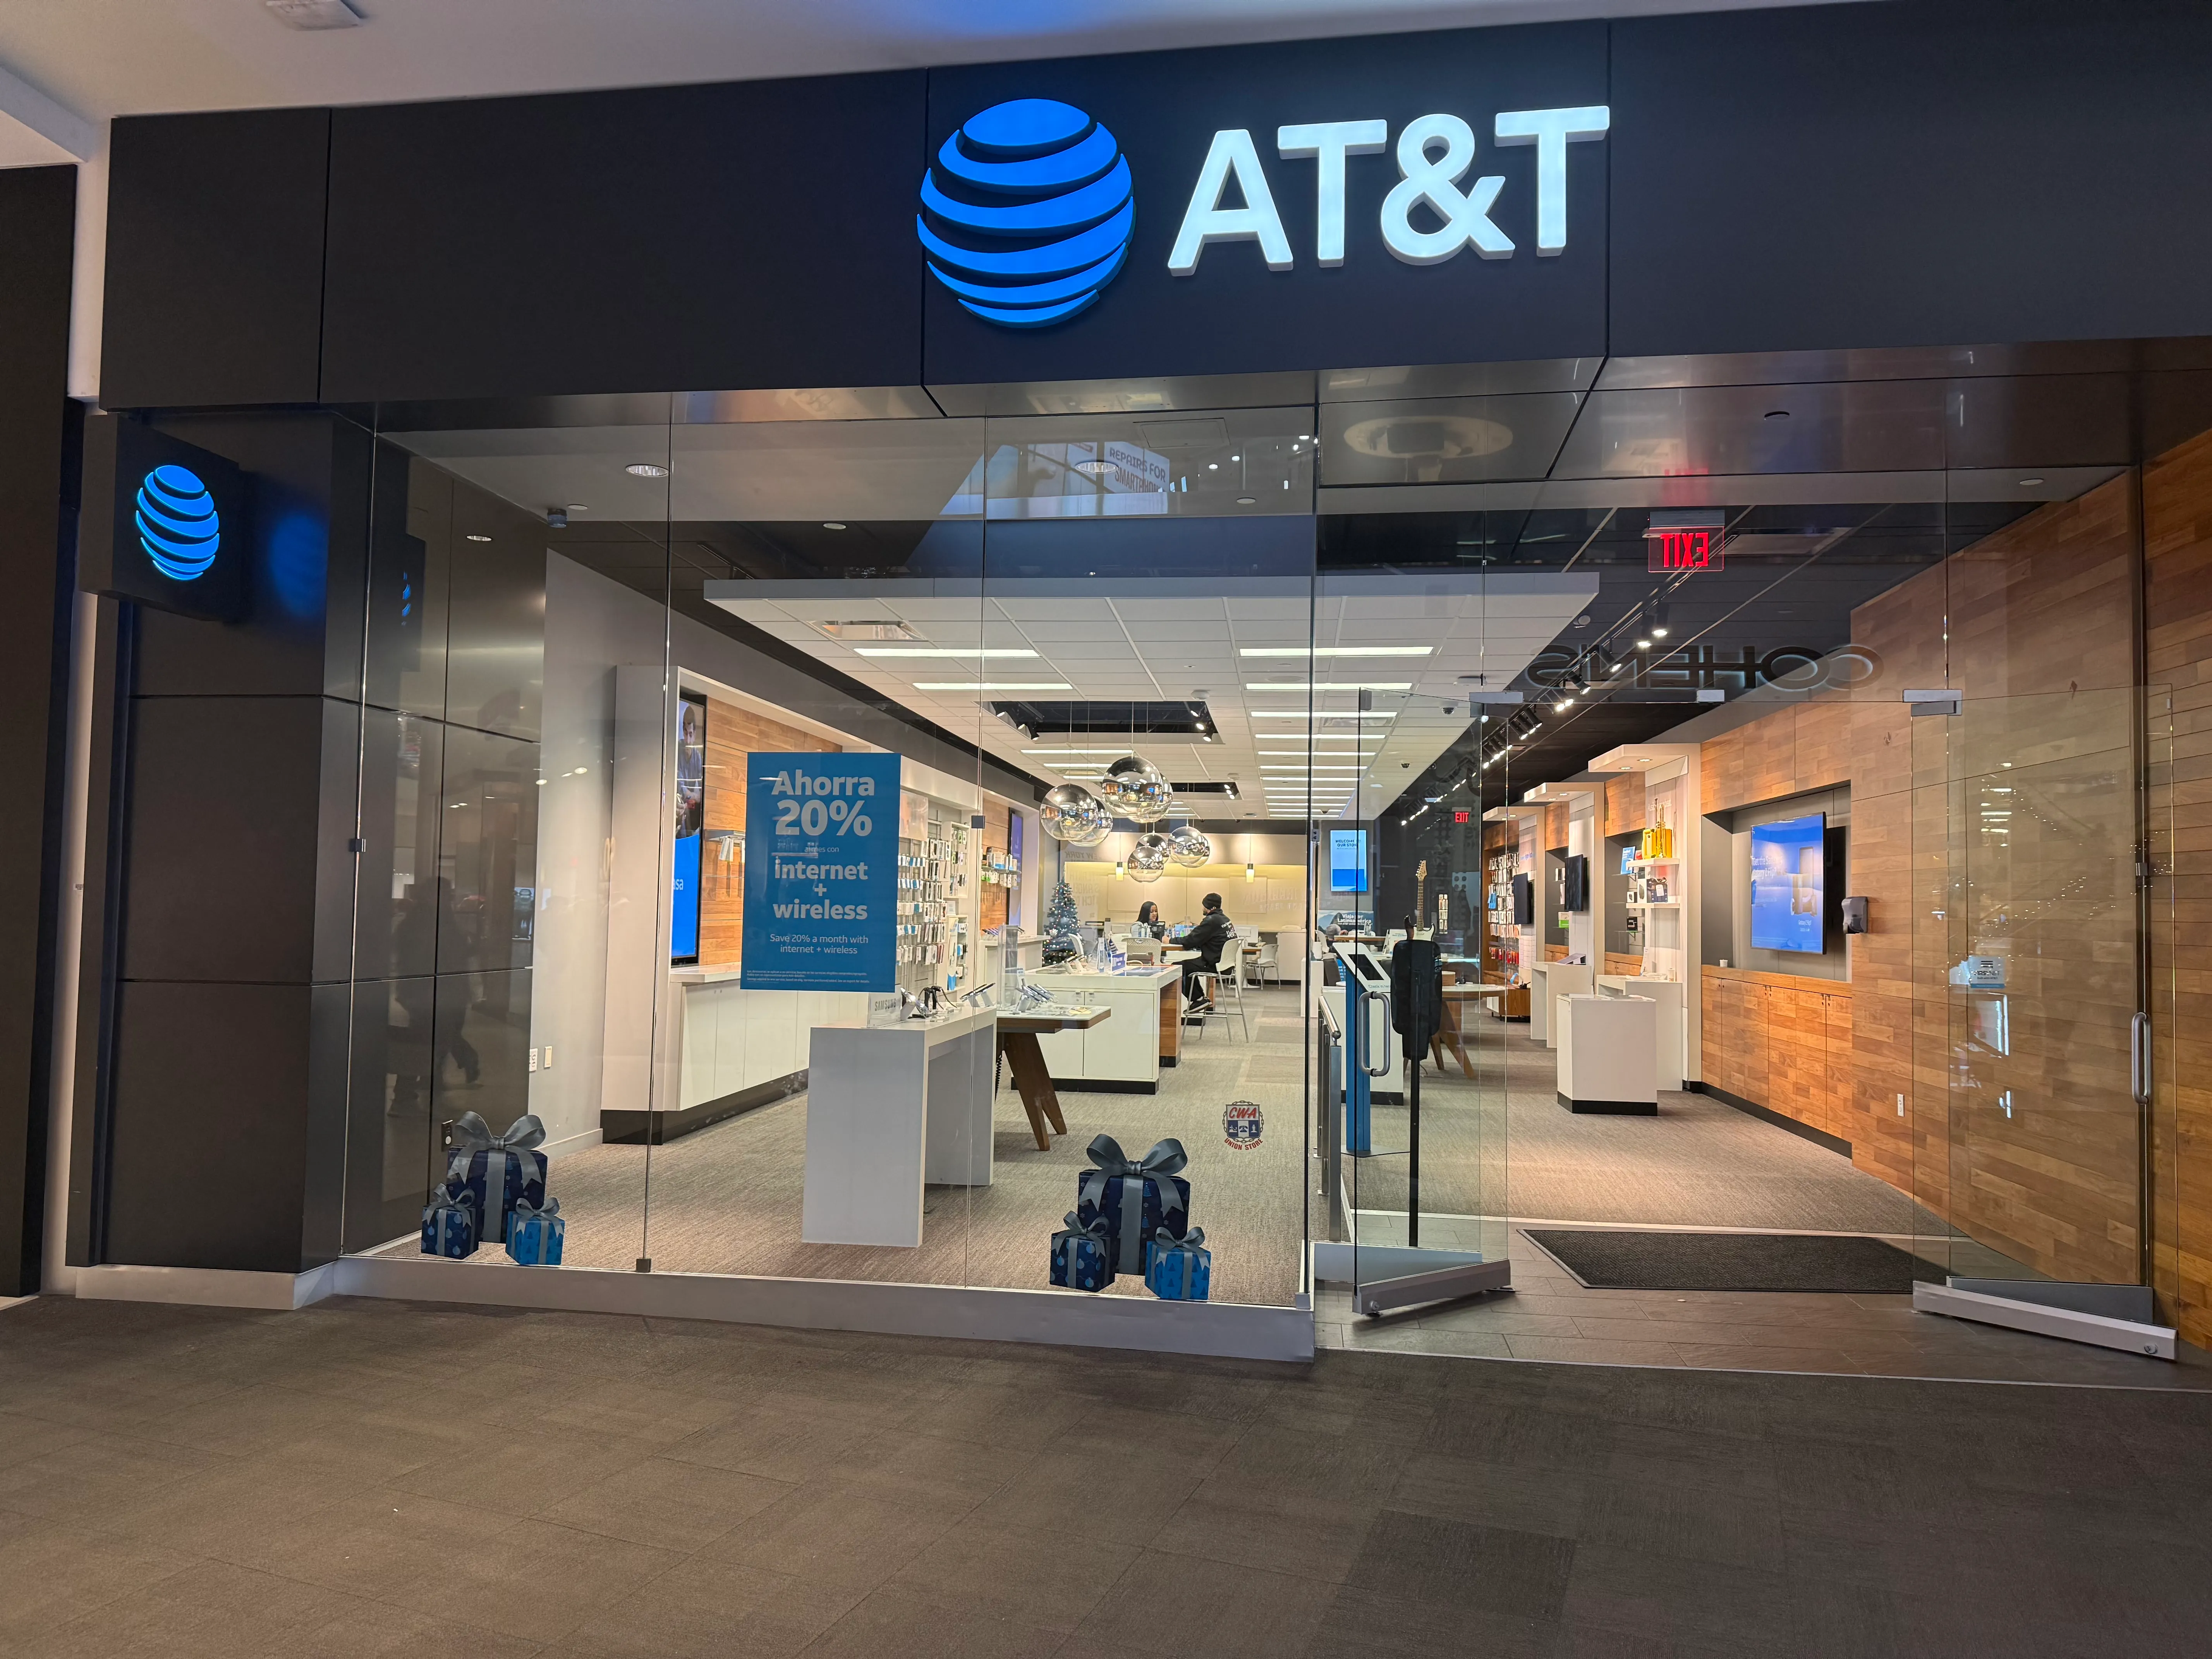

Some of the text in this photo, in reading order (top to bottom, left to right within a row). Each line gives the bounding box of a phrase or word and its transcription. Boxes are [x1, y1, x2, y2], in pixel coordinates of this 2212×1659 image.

[1168, 106, 1610, 276] AT&T
[1109, 447, 1166, 483] REPAIRS FOR
[771, 769, 874, 795] Ahorra
[776, 800, 872, 836] 20%
[1455, 812, 1469, 822] EXIT
[775, 857, 868, 880] internet
[814, 883, 826, 896] +
[773, 899, 867, 920] wireless
[820, 935, 847, 943] month
[850, 936, 868, 944] with
[780, 945, 814, 953] internet
[824, 946, 857, 954] wireless
[874, 998, 896, 1011] SAMSUNG
[1229, 1107, 1257, 1119] CWA
[1224, 1138, 1263, 1150] UNION STORE
